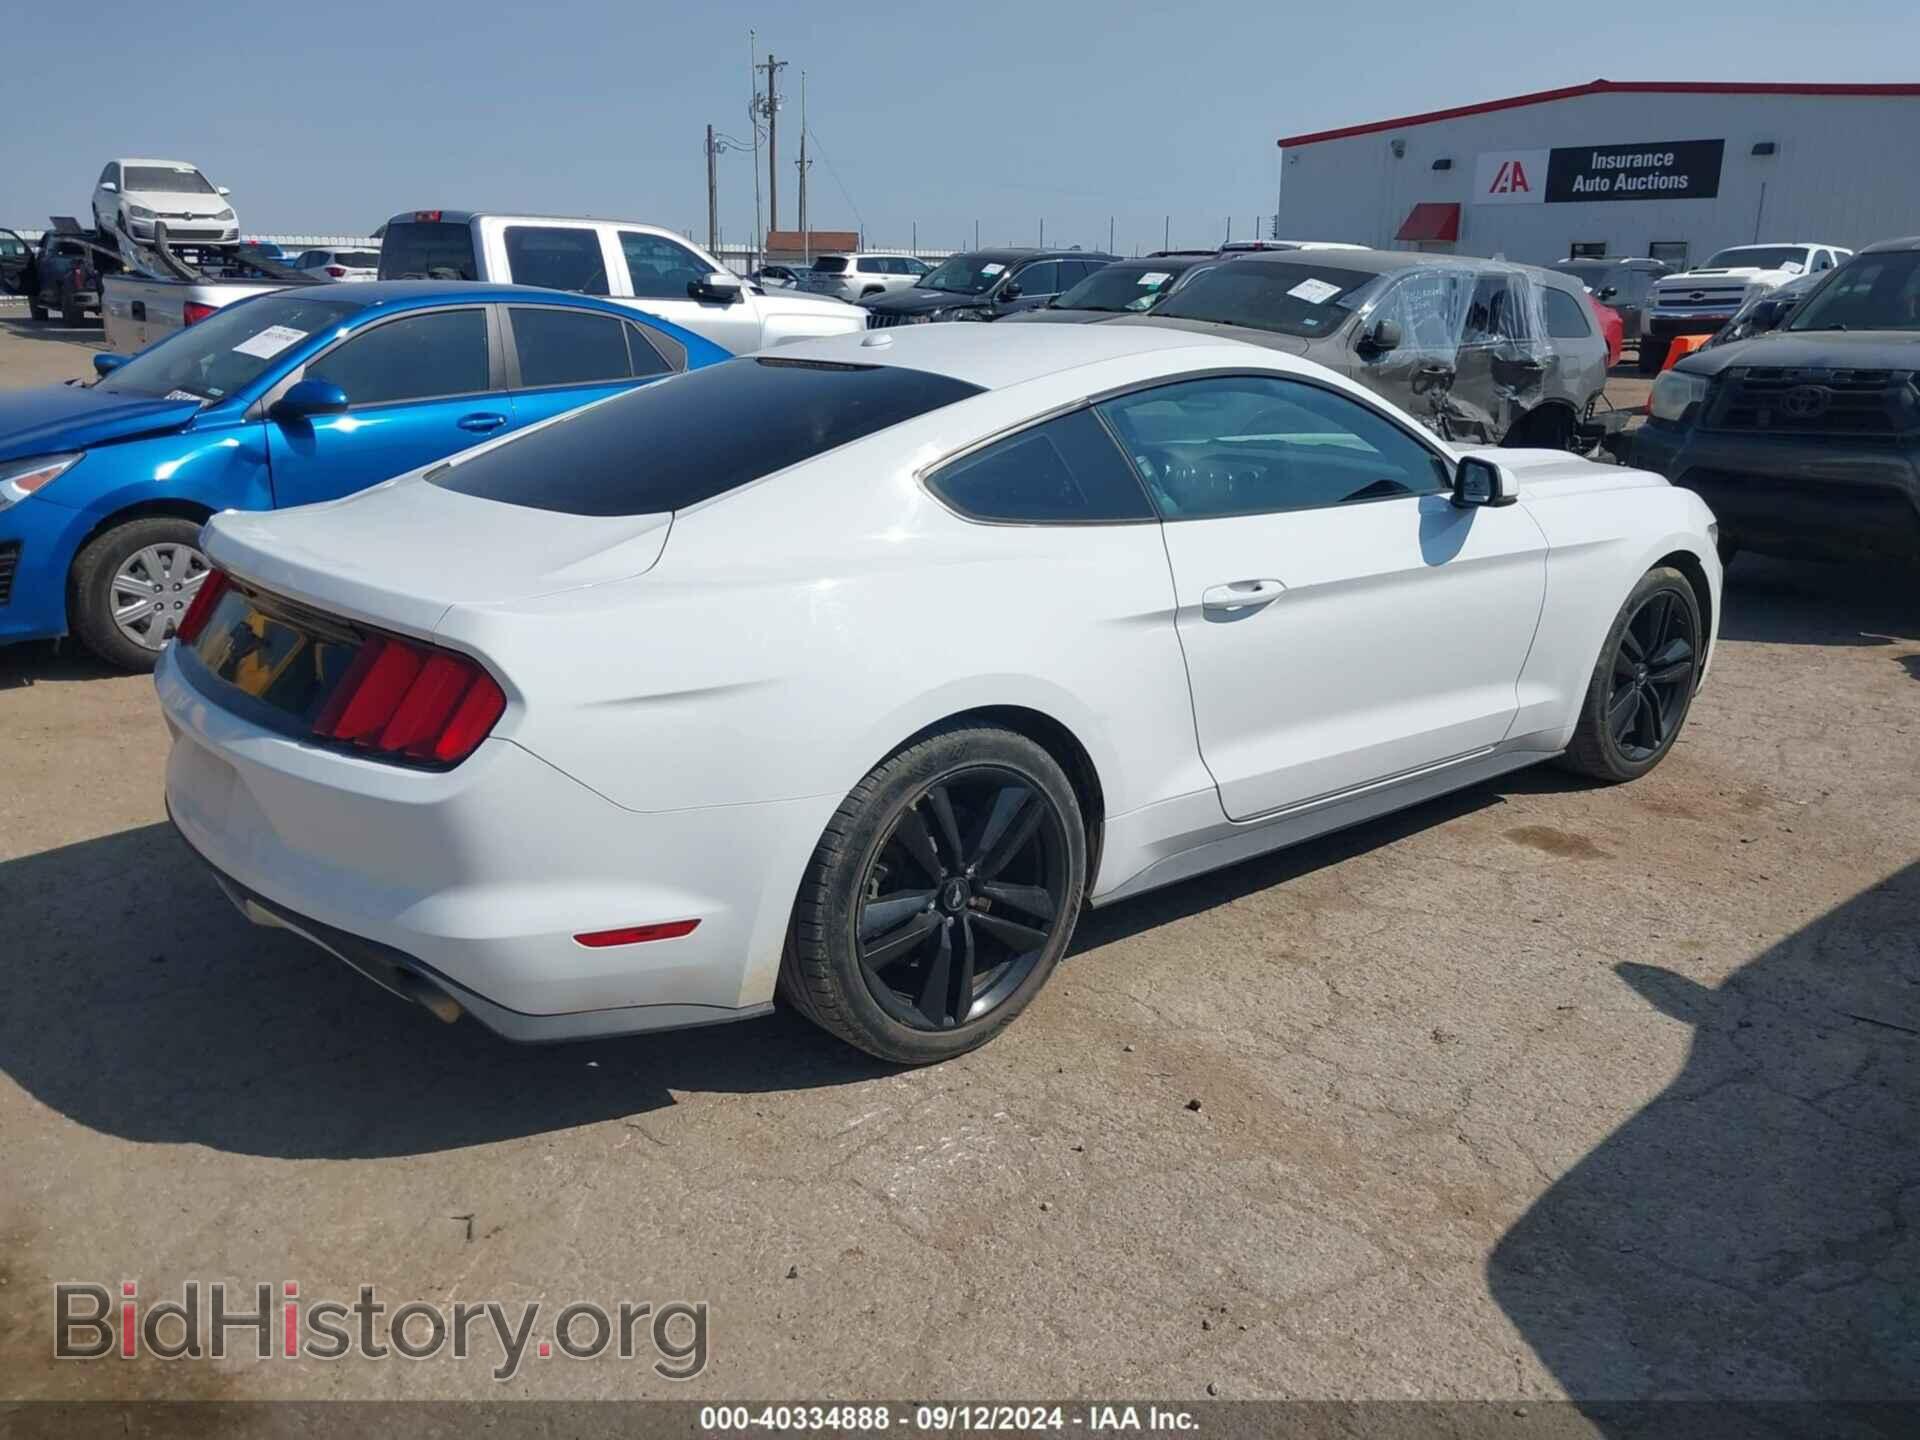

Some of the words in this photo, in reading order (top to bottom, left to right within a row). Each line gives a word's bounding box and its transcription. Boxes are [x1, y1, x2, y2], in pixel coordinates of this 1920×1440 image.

[1591, 151, 1674, 170] Insurance
[1572, 174, 1610, 193] Auto
[1614, 172, 1689, 191] Auctions
